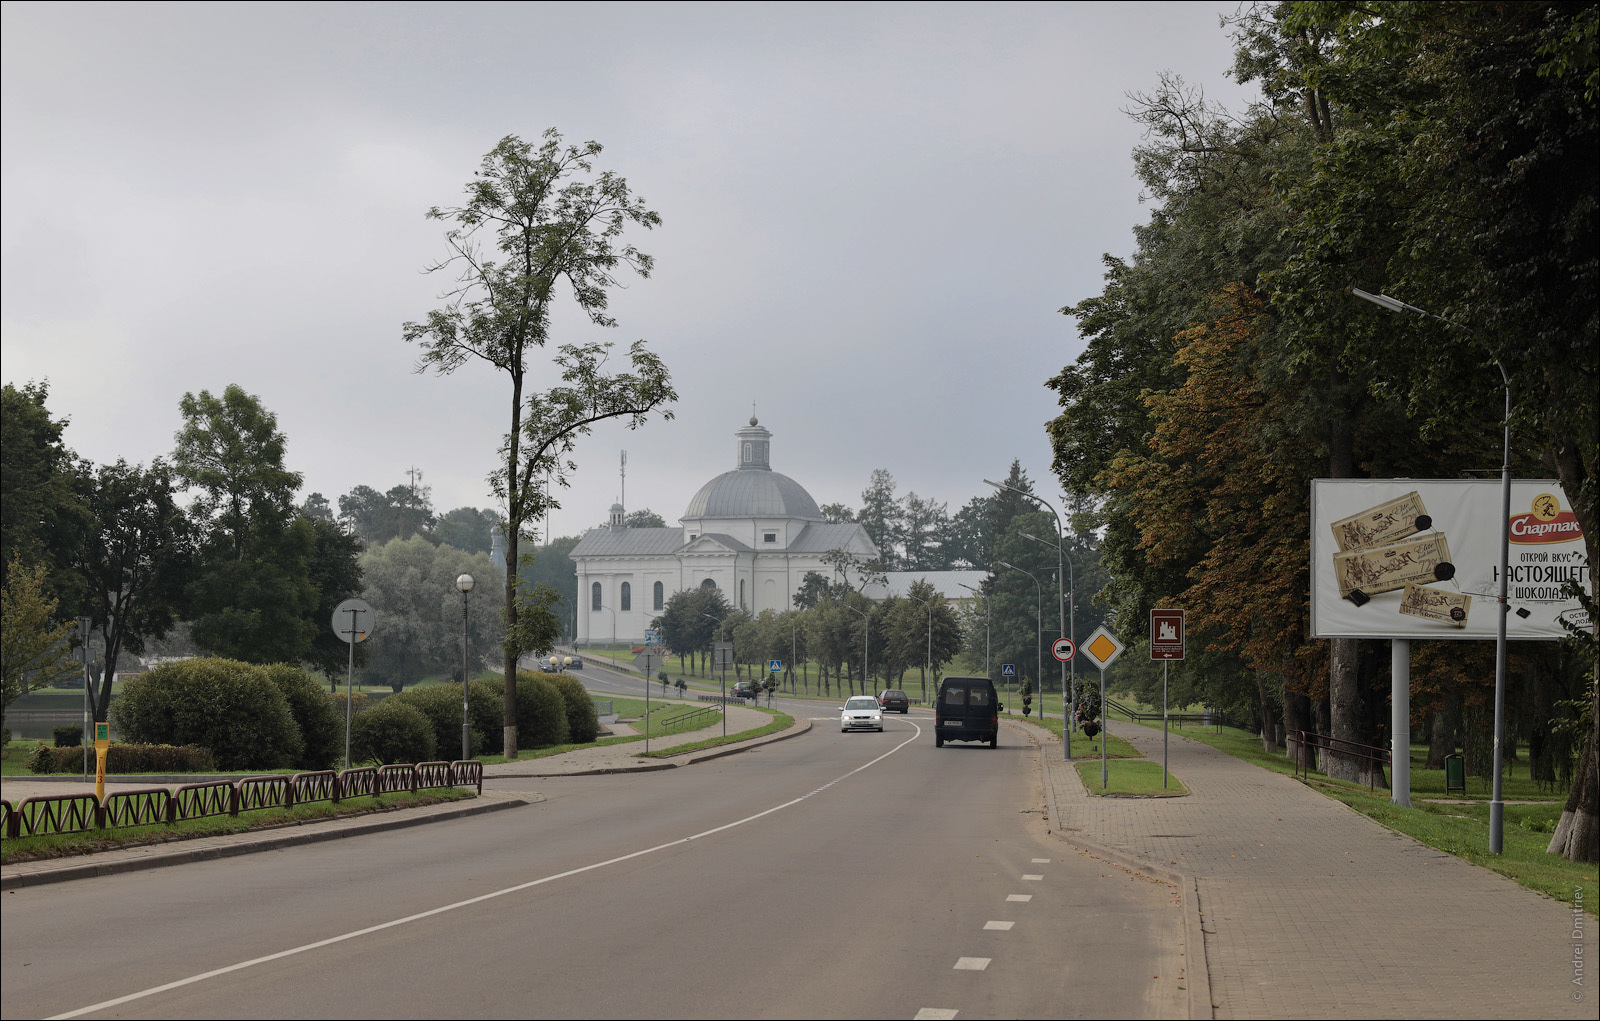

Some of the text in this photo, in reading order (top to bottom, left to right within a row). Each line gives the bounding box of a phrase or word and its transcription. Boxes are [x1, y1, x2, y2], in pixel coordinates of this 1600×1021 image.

[1511, 516, 1580, 536] Спартак
[1520, 552, 1571, 563] ОТКРОЙ ВКУС
[1516, 587, 1576, 600] ШОКОЛАД
